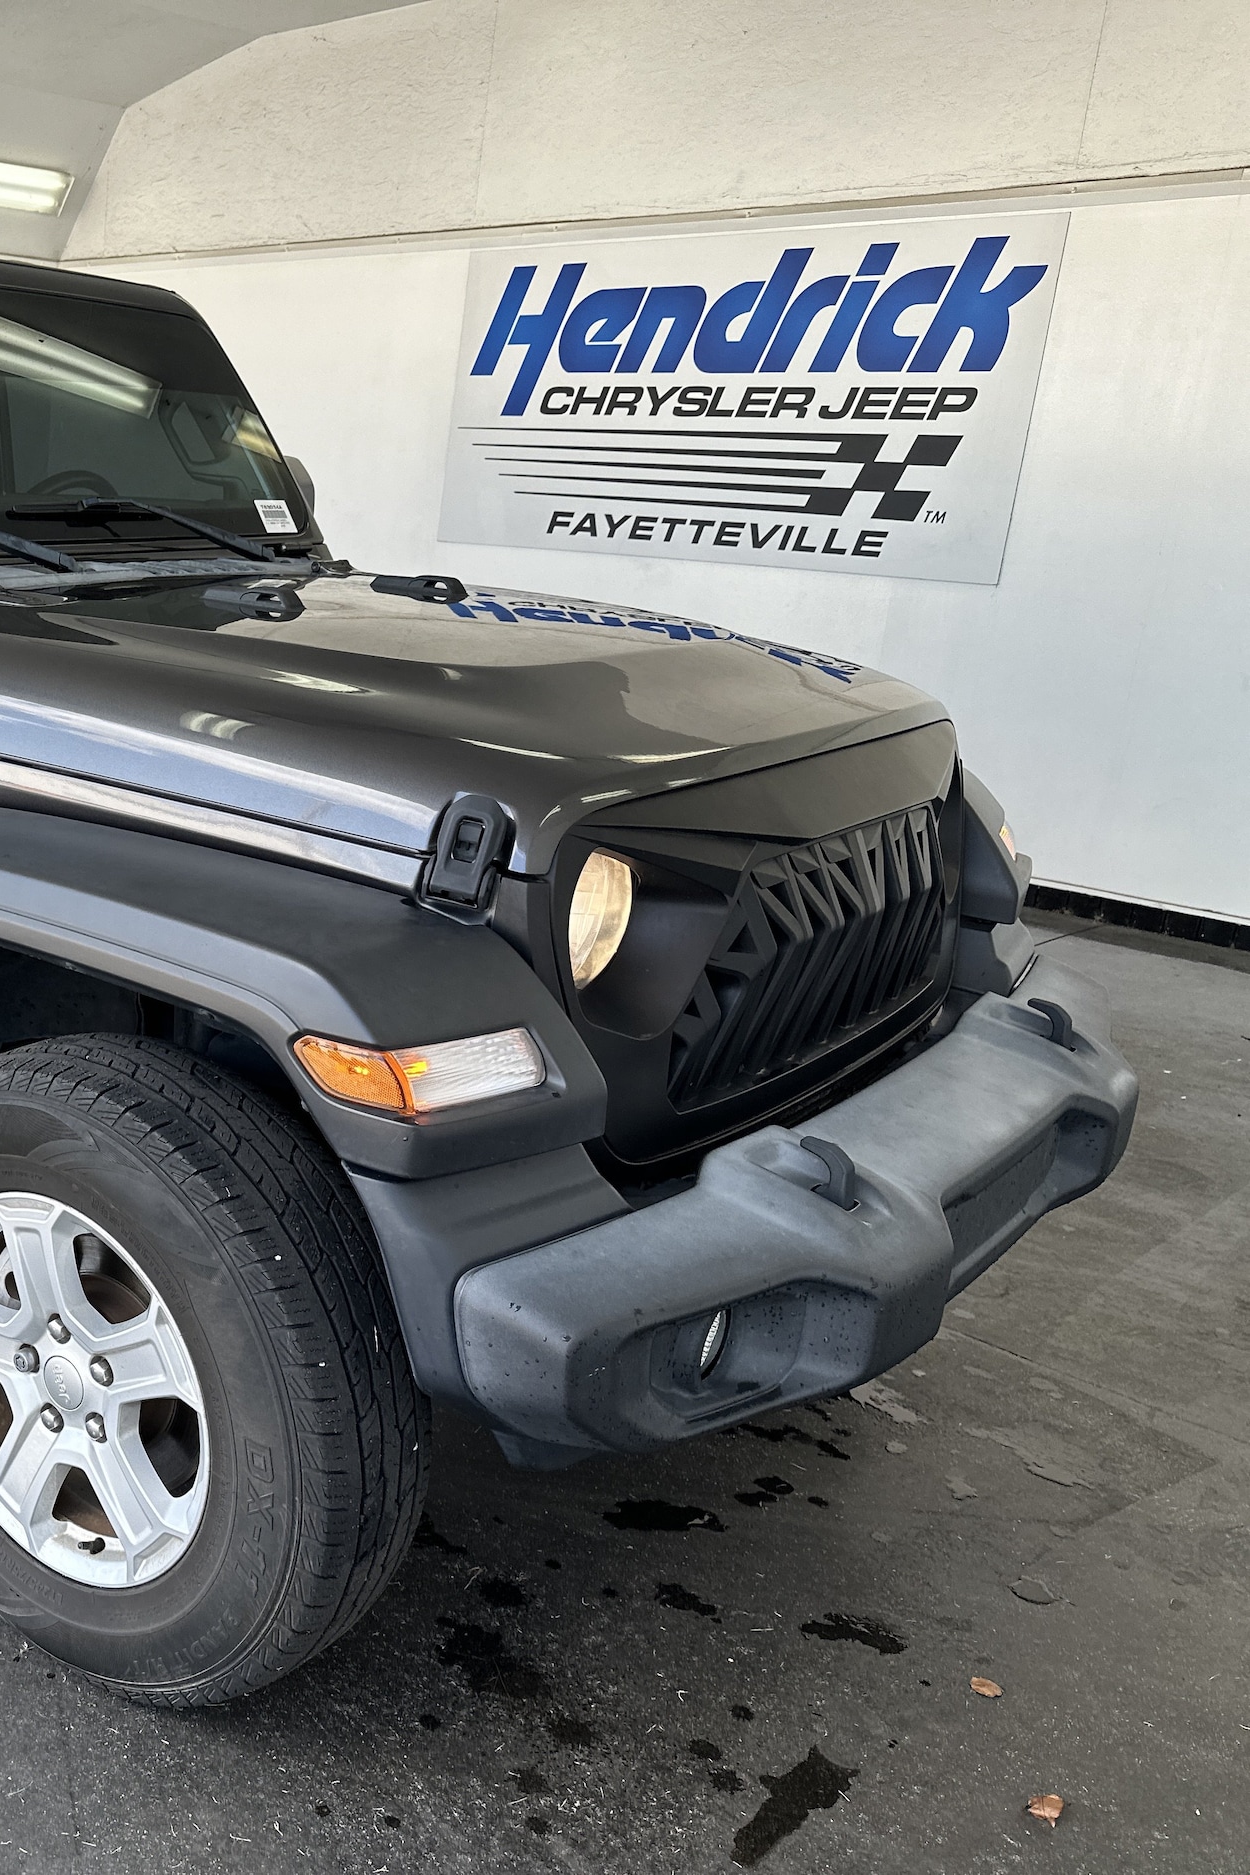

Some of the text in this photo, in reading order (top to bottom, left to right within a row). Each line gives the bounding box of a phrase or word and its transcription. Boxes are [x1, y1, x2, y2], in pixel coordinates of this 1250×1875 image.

[470, 236, 1049, 417] Hendrick
[539, 386, 979, 421] CHRYSLER JEEP
[546, 510, 889, 558] FAYETTEVILLE
[924, 510, 947, 524] TM
